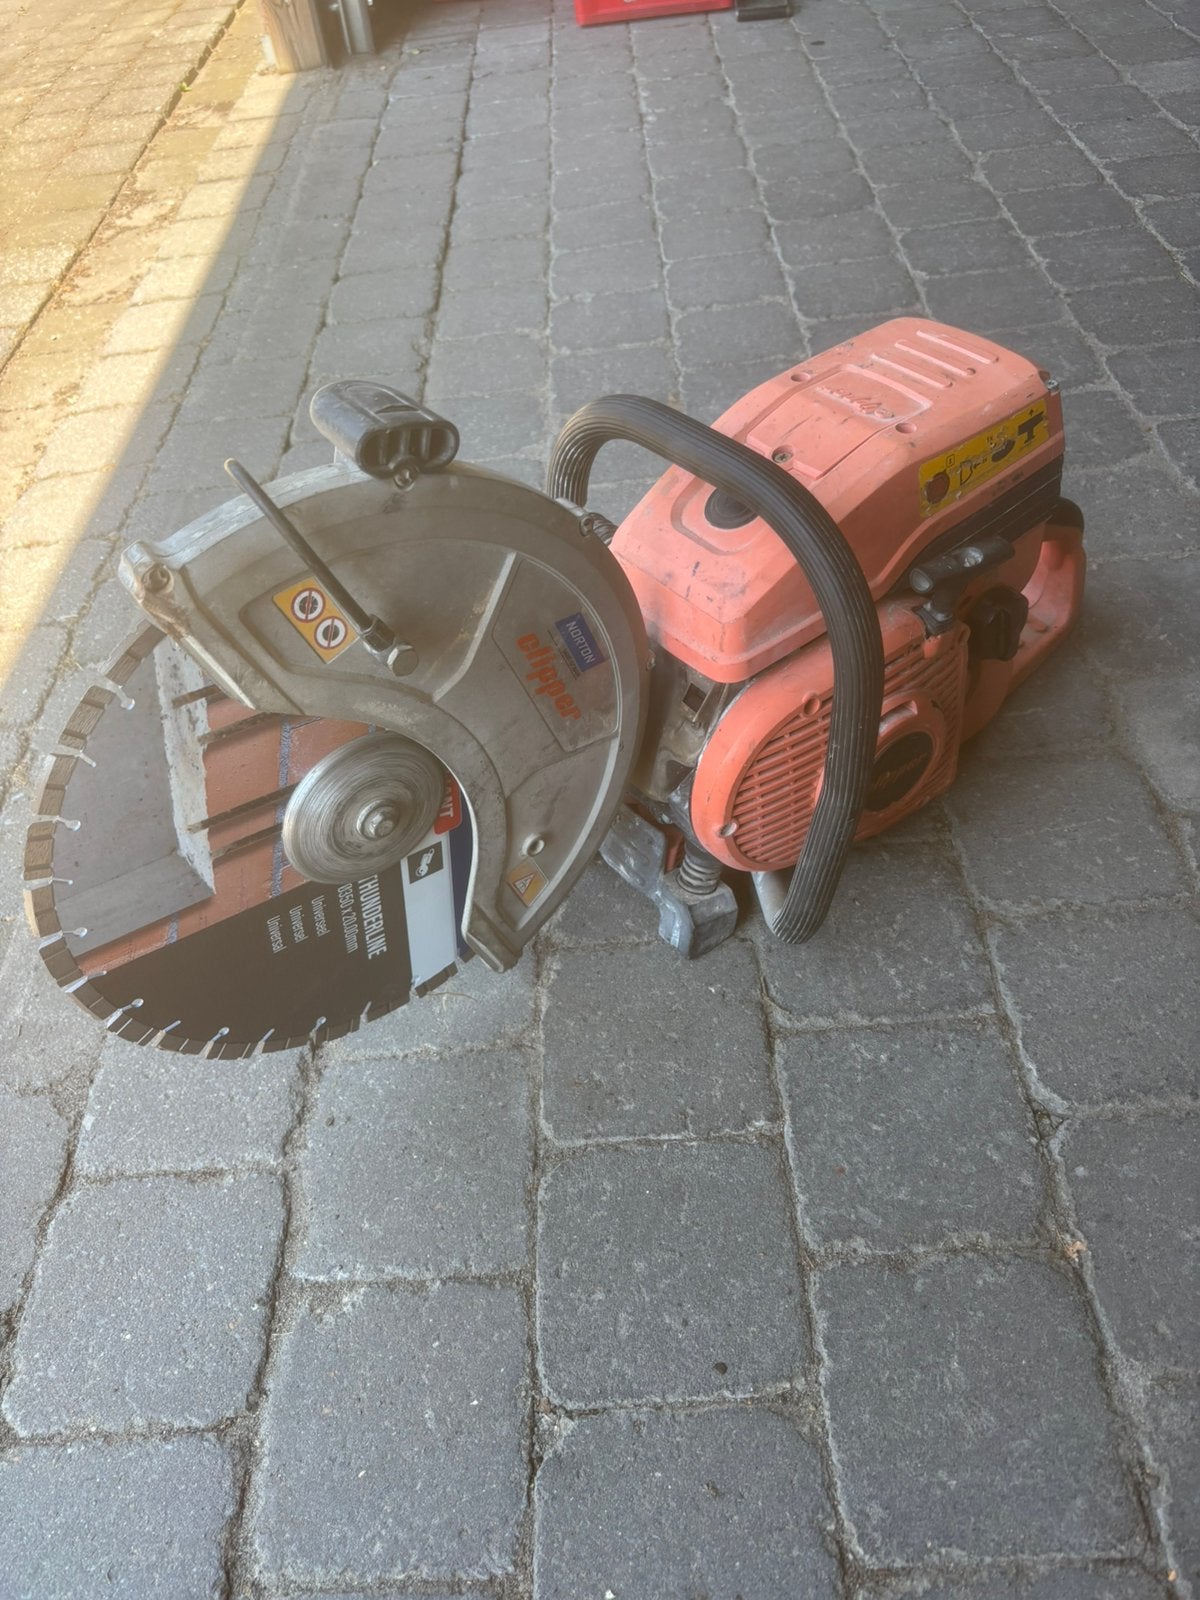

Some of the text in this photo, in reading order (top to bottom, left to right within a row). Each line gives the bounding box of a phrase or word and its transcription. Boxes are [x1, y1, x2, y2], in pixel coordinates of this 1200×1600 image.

[565, 620, 596, 664] NORTON
[516, 633, 582, 720] clipper
[266, 915, 287, 954] Universal
[289, 905, 308, 943] Universel
[358, 874, 387, 960] THUNDERLINE
